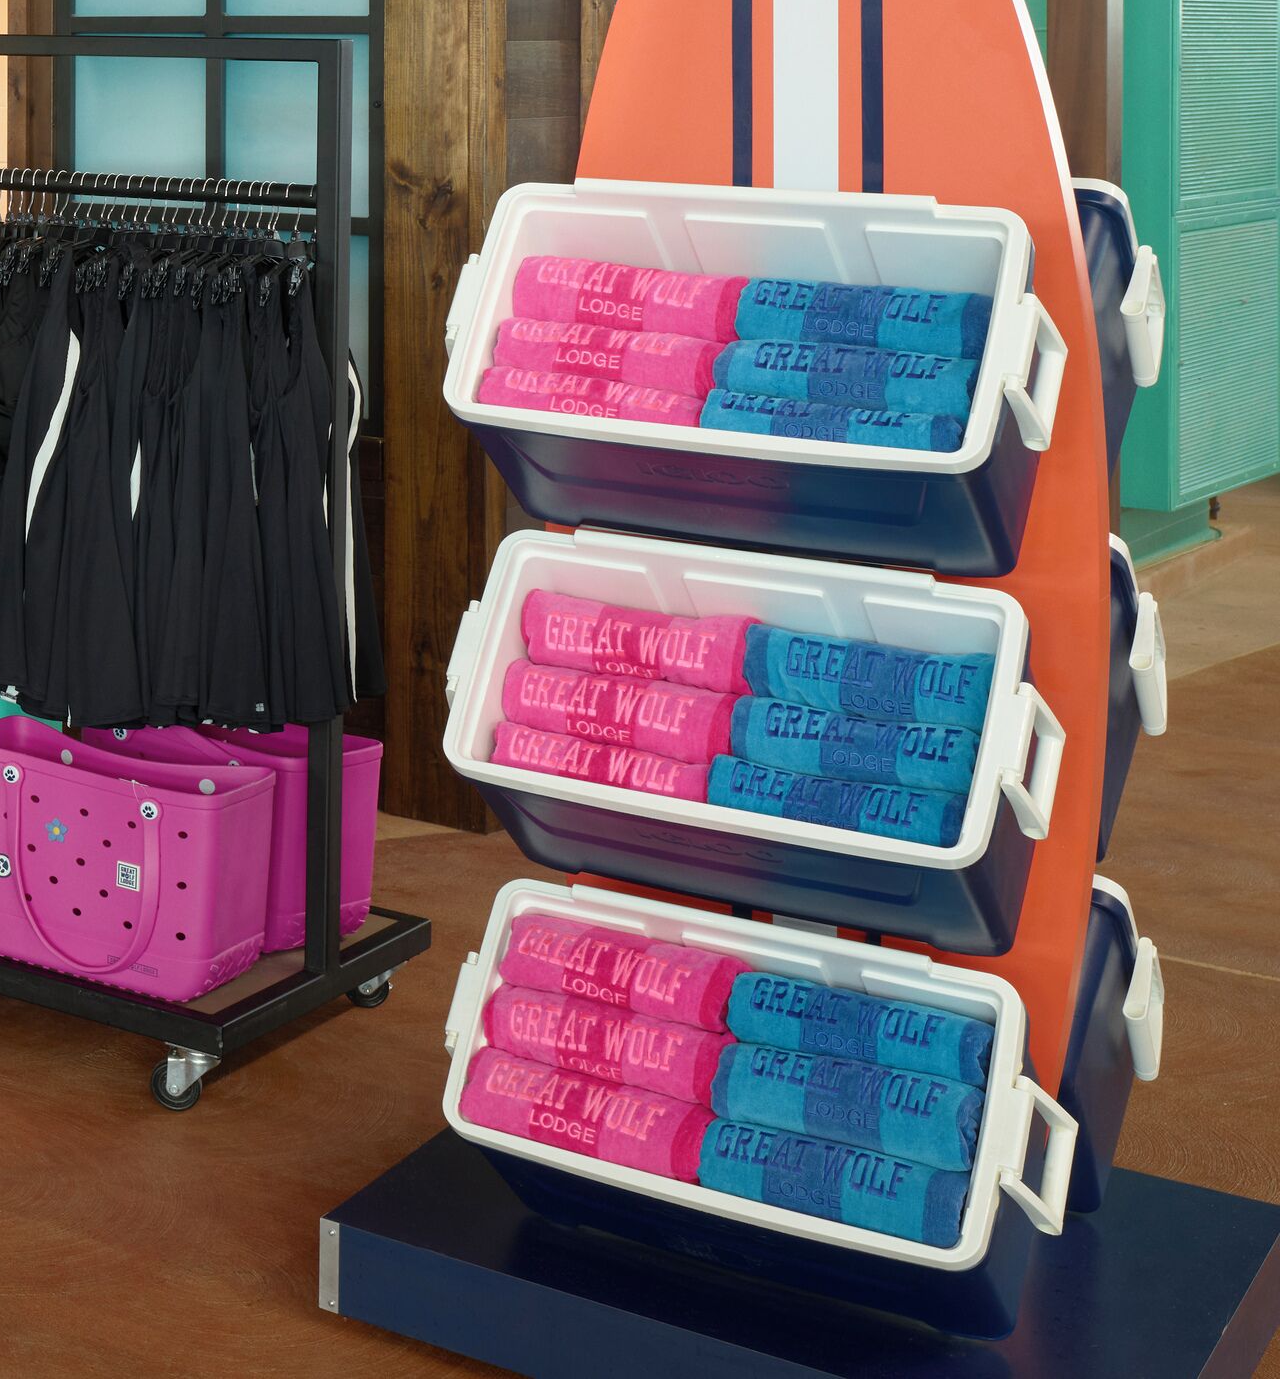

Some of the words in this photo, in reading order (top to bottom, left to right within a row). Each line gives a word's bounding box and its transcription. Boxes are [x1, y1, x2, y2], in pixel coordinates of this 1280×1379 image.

[537, 258, 627, 294] GREAT
[631, 269, 711, 308] WOLF
[754, 280, 853, 313] GREAT
[860, 289, 947, 323] WOLF
[579, 296, 643, 321] LODGE
[802, 318, 875, 338] LODGE
[555, 348, 621, 369] LODGE
[754, 342, 855, 373] GREAT
[864, 352, 952, 379] WOLF
[550, 396, 618, 419] LODGE
[808, 380, 881, 399] LODGE
[545, 613, 632, 653] GREAT
[639, 626, 716, 669] WOLF
[786, 637, 887, 688] GREAT
[891, 657, 978, 704] WOLF
[520, 672, 608, 716] GREAT
[614, 684, 694, 735] WOLF
[841, 694, 912, 715] LODGE
[567, 719, 631, 742] LODGE
[765, 703, 865, 743] GREAT
[875, 723, 963, 763] WOLF
[510, 729, 600, 775] GREAT
[608, 747, 687, 792] WOLF
[820, 750, 895, 772] LODGE
[730, 760, 833, 806] GREAT
[839, 783, 928, 827] WOLF
[518, 924, 608, 975] GREAT
[611, 948, 690, 1004] WOLF
[562, 974, 627, 1004] LODGE
[750, 977, 851, 1024] GREAT
[856, 1000, 945, 1047] WOLF
[510, 1000, 597, 1052] GREAT
[604, 1020, 683, 1071] WOLF
[801, 1028, 876, 1058] LODGE
[486, 1059, 580, 1109] GREAT
[582, 1087, 665, 1140] WOLF
[751, 1047, 853, 1090] GREAT
[859, 1067, 947, 1118] WOLF
[529, 1109, 596, 1144] LODGE
[807, 1100, 878, 1130] LODGE
[715, 1124, 817, 1174] GREAT
[822, 1145, 912, 1199] WOLF
[766, 1179, 841, 1209] LODGE
